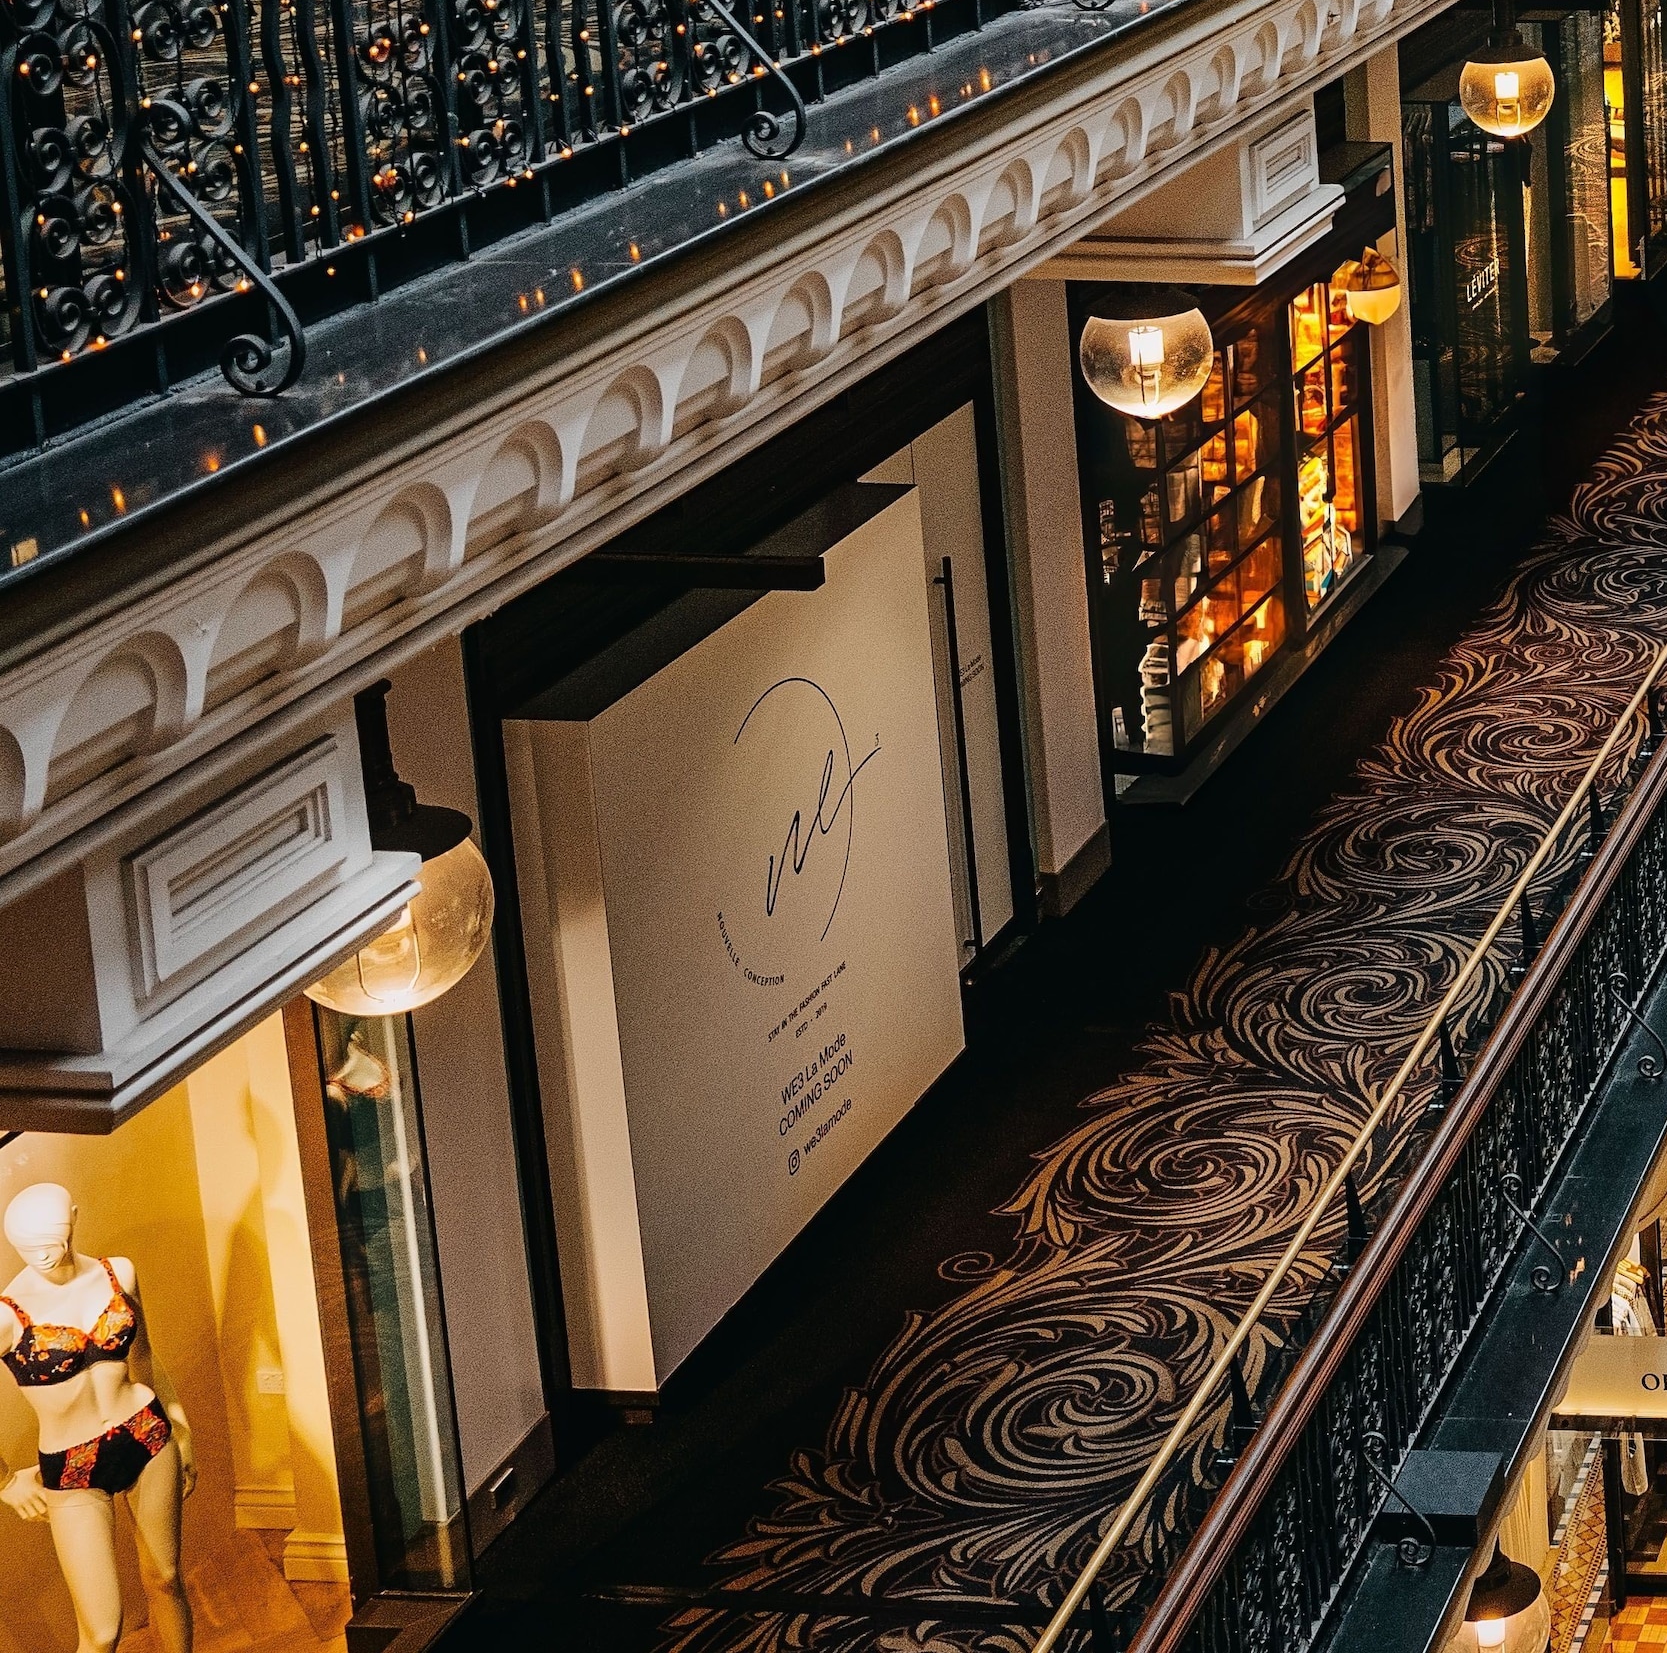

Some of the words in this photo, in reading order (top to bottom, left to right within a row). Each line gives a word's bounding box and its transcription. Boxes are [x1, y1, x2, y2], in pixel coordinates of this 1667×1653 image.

[717, 911, 740, 967] NOUVELLE
[743, 967, 785, 986] CONCEPTION
[767, 1025, 780, 1043] STAY
[781, 1018, 788, 1030] IN
[788, 1007, 799, 1022] THE
[799, 986, 820, 1012] FASHION
[821, 974, 833, 990] FAST
[833, 960, 847, 979] LANE
[795, 1021, 808, 1038] ESTD
[779, 1082, 822, 1137] COMING
[823, 1049, 854, 1091] SOON
[781, 1071, 804, 1106] WE3
[805, 1061, 818, 1082] La
[819, 1033, 846, 1069] Mode
[803, 1098, 852, 1156] we3lamode
